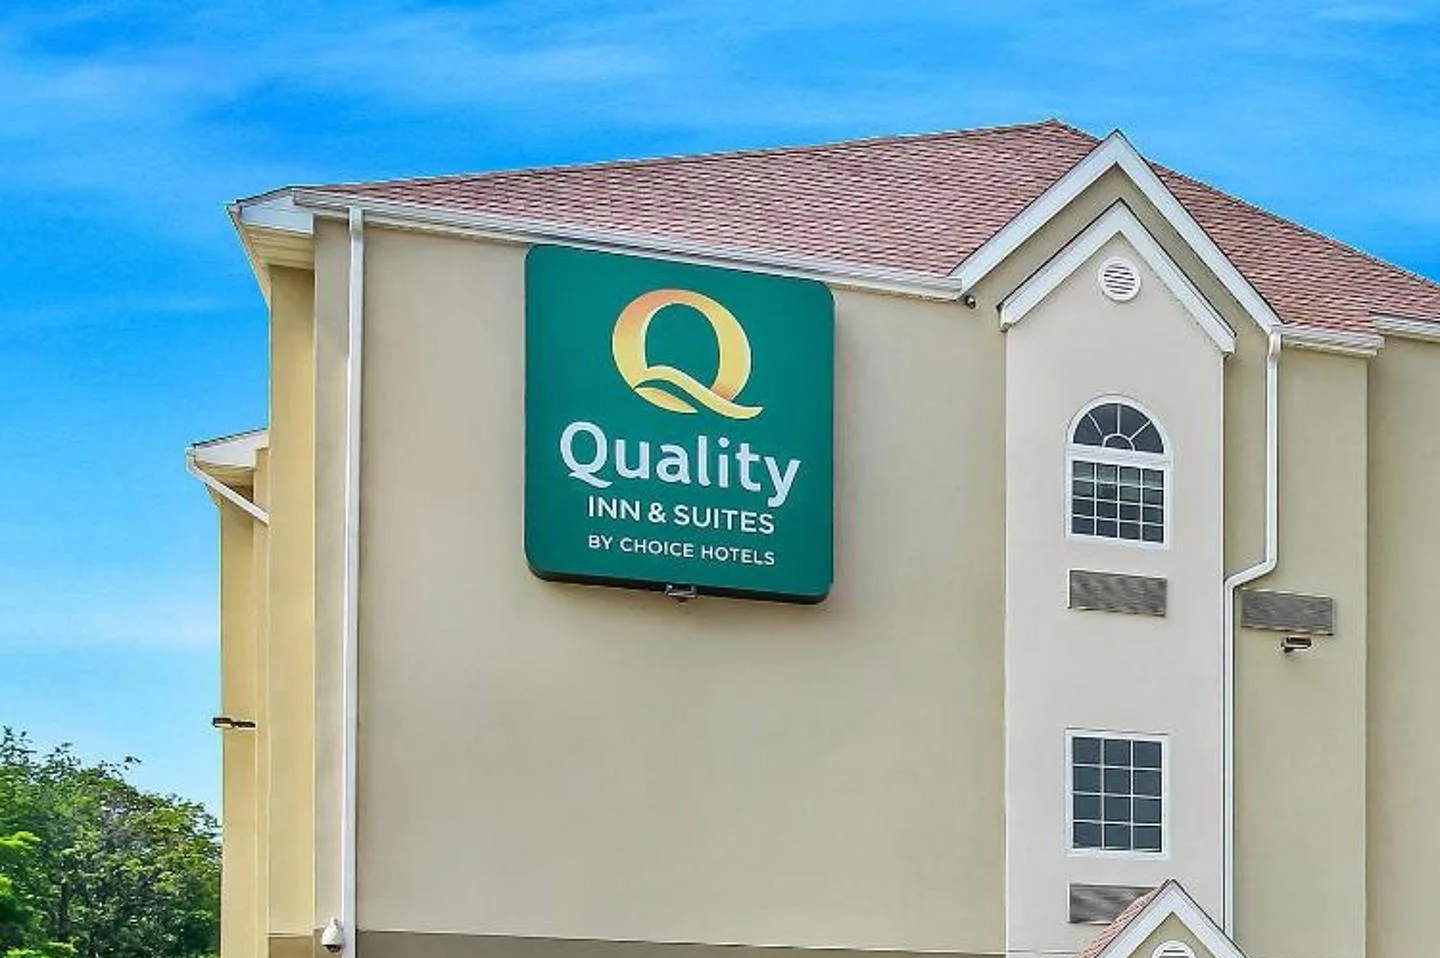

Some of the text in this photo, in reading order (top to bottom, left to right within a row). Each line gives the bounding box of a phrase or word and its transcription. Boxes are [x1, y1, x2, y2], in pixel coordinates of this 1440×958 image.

[611, 288, 765, 420] Q
[559, 421, 802, 508] Quality
[588, 495, 775, 535] INN & SUITES
[588, 535, 775, 565] BY CHOICE HOTELS
